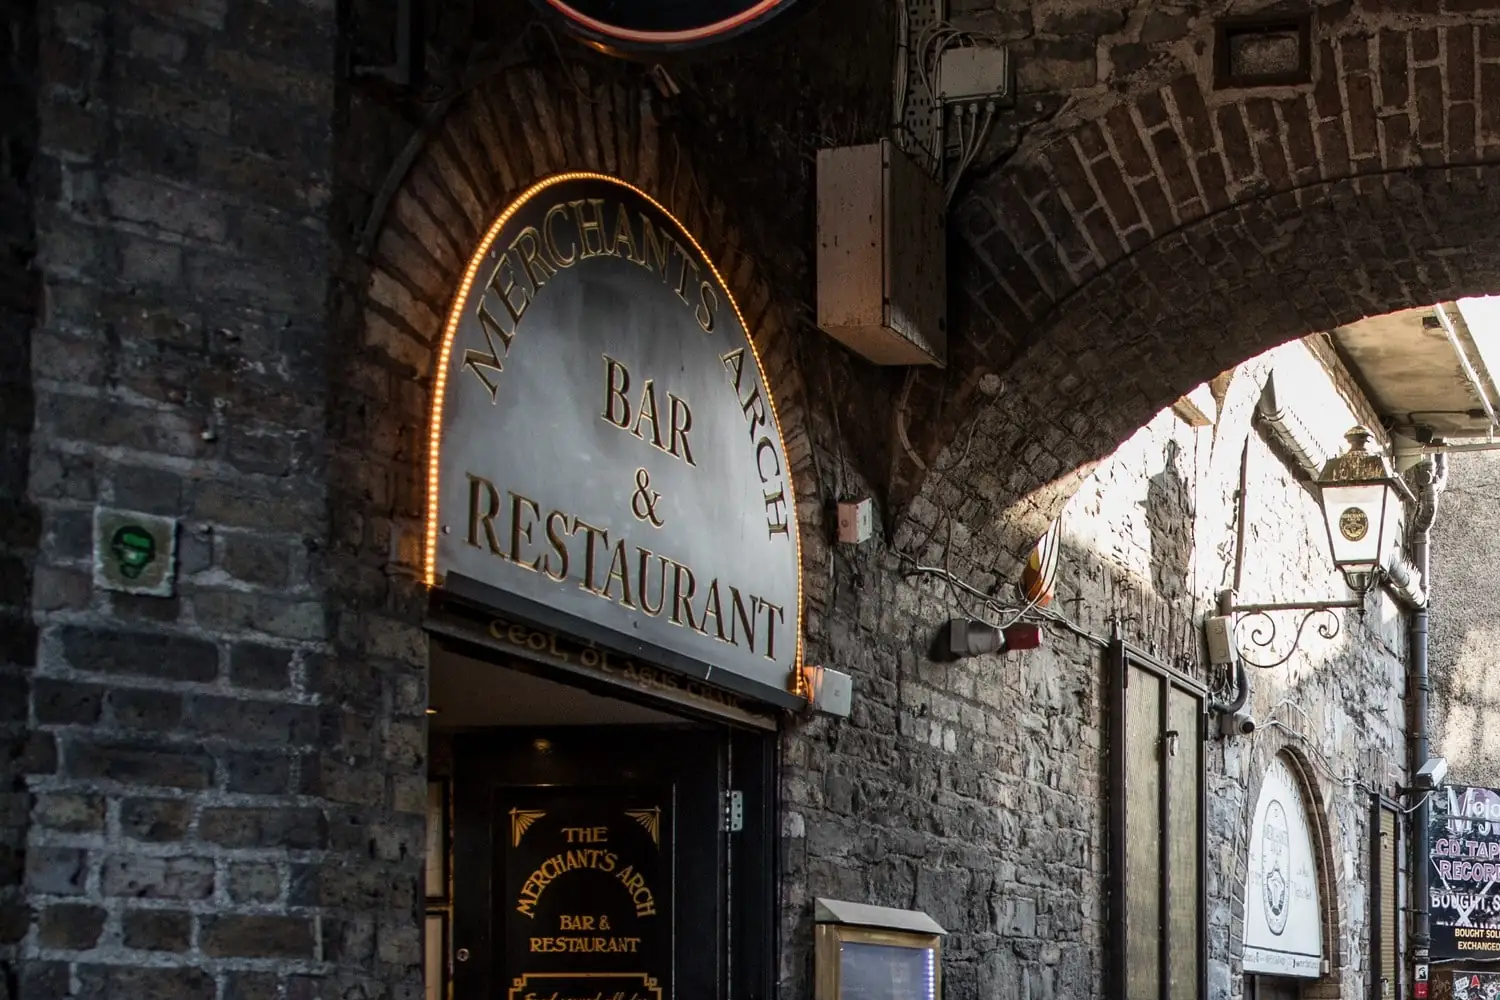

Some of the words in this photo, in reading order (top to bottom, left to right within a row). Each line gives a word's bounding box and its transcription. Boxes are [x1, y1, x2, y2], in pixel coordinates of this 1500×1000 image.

[601, 353, 696, 467] BAR
[719, 347, 791, 541] ARCH
[631, 467, 665, 527] &
[463, 472, 784, 661] RESTAURANT
[560, 826, 609, 843] THE
[1435, 838, 1461, 857] CD
[615, 864, 657, 919] ARCH
[559, 914, 596, 931] BAR
[598, 914, 611, 931] &
[1454, 928, 1485, 938] BOUGHT
[529, 936, 641, 953] RESTAURANT
[1457, 941, 1500, 951] EXCHANGED
